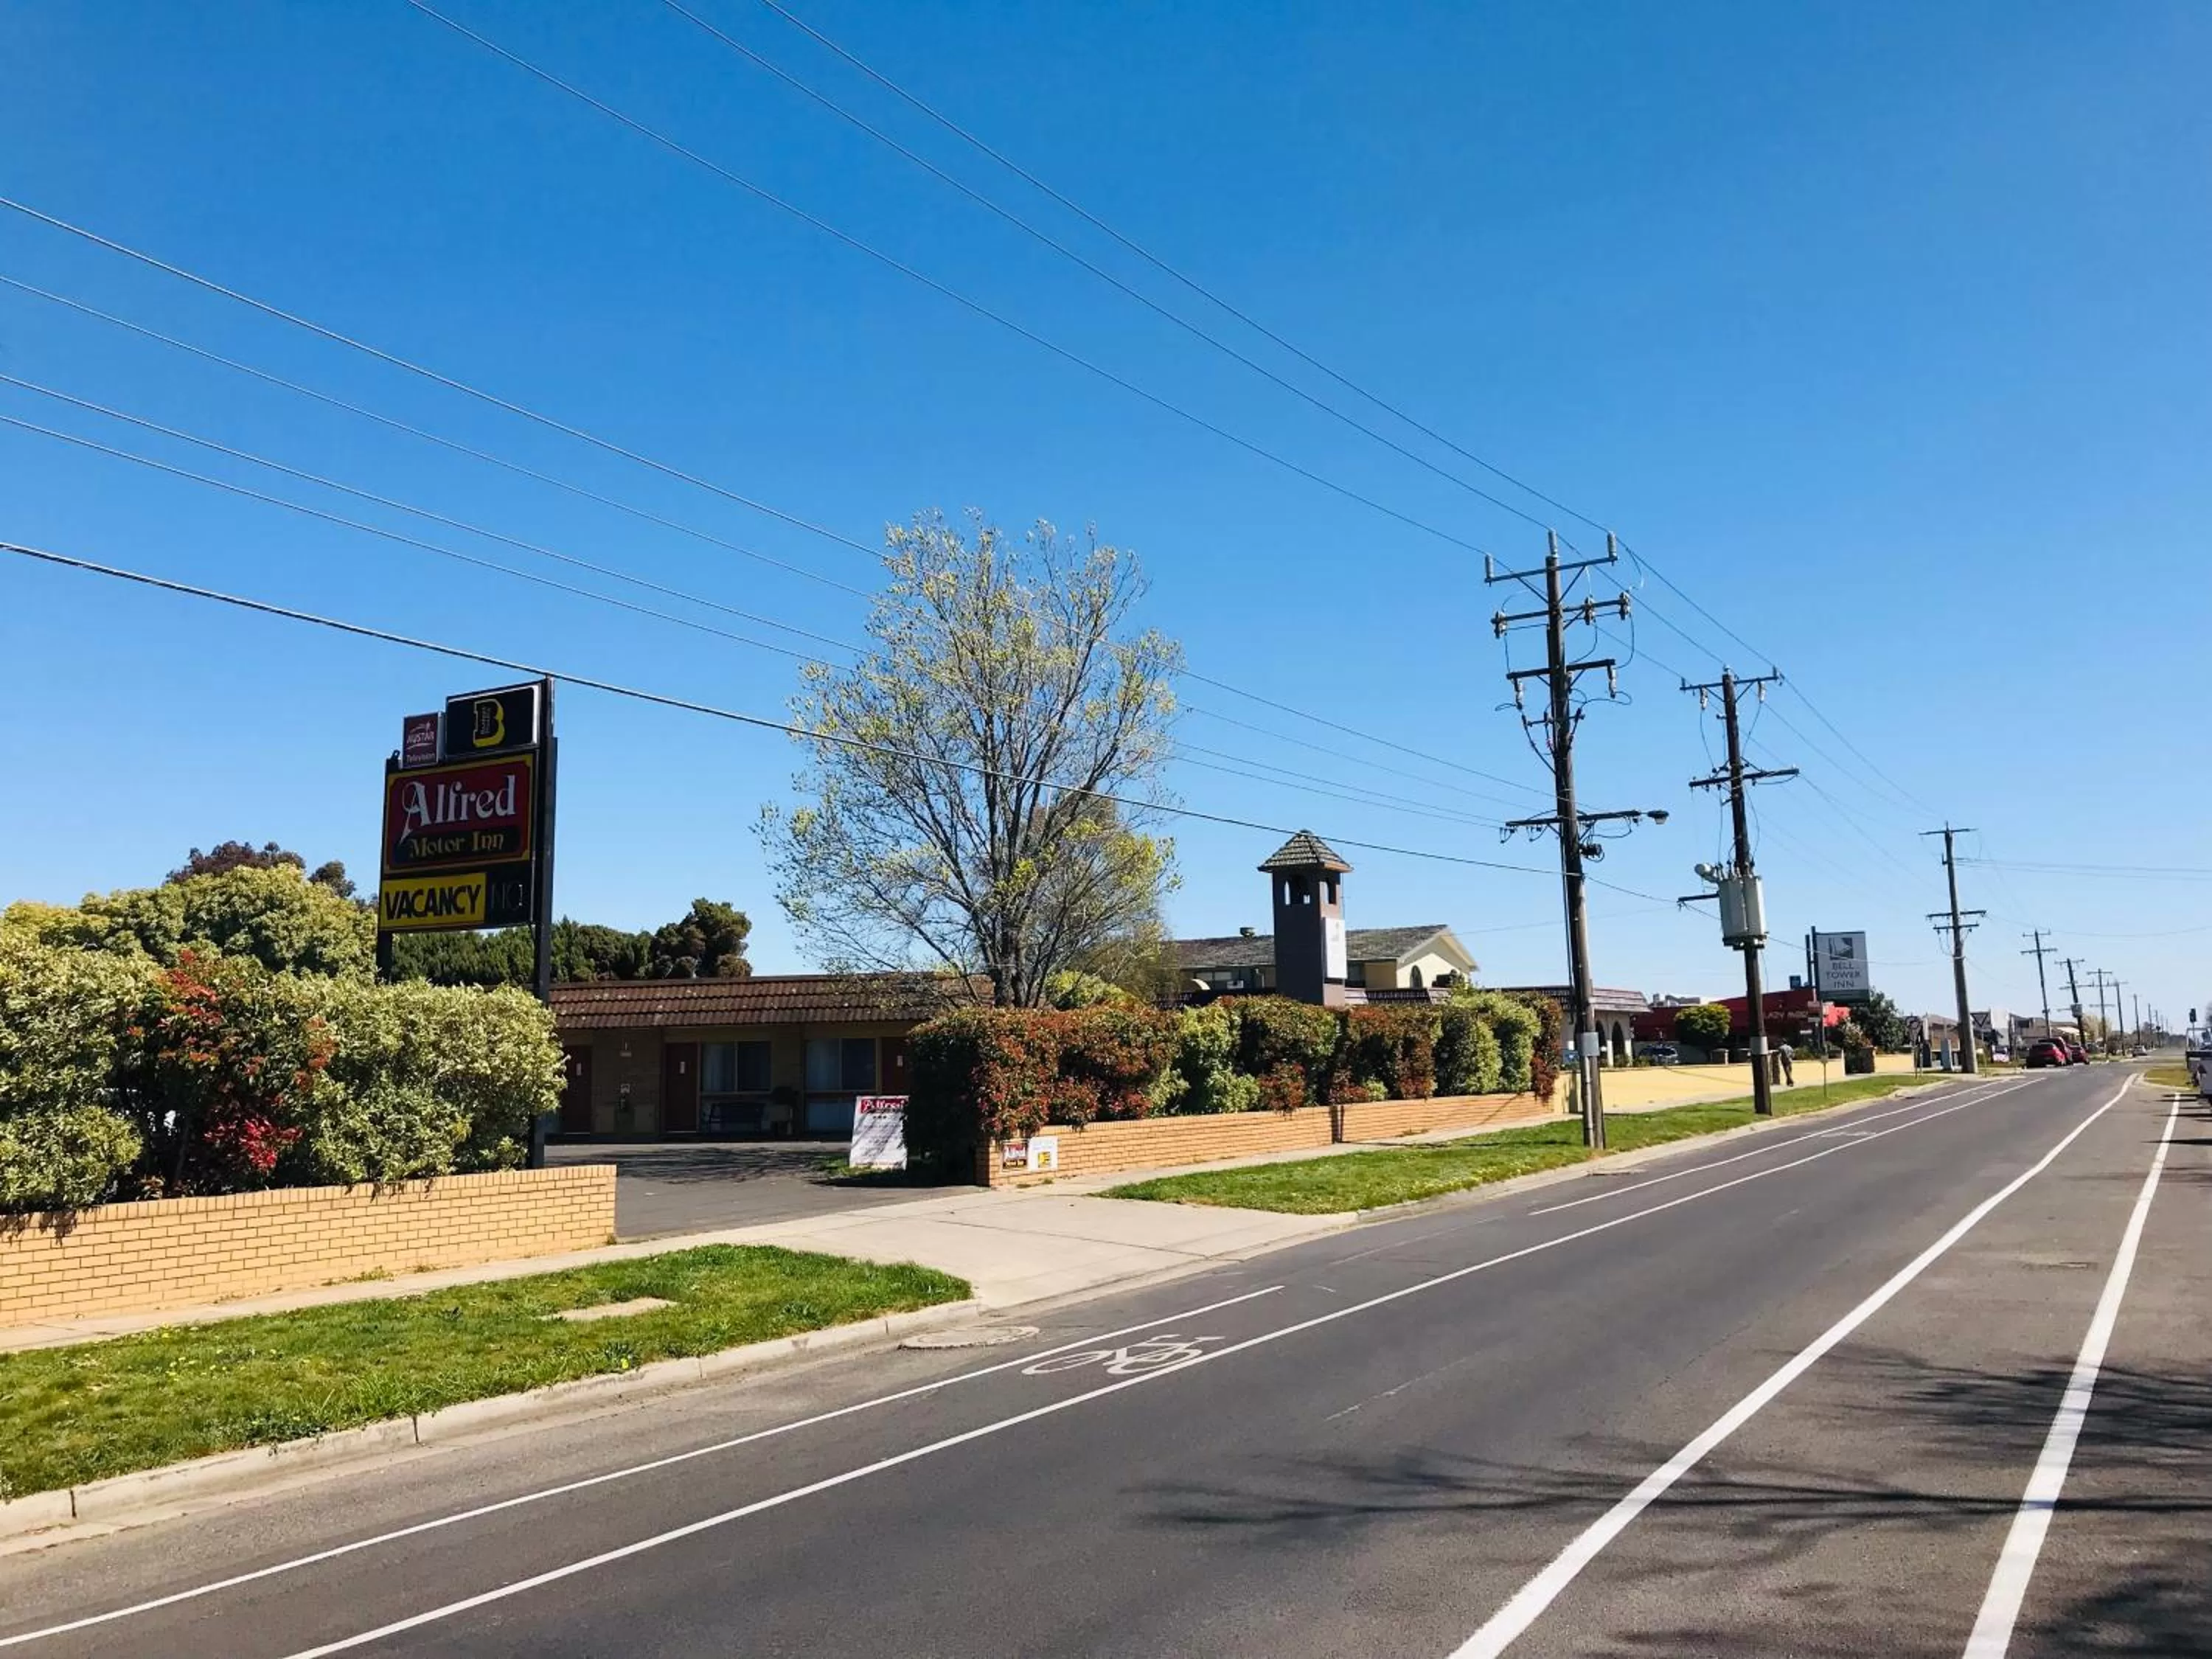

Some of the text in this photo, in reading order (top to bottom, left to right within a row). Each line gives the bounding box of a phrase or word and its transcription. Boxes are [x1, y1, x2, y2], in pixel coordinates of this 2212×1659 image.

[400, 774, 515, 844] Alfred
[409, 831, 504, 858] Motor Inn
[384, 884, 481, 920] VACANCY
[1826, 970, 1860, 979] TOWER
[1832, 961, 1854, 970] BELL
